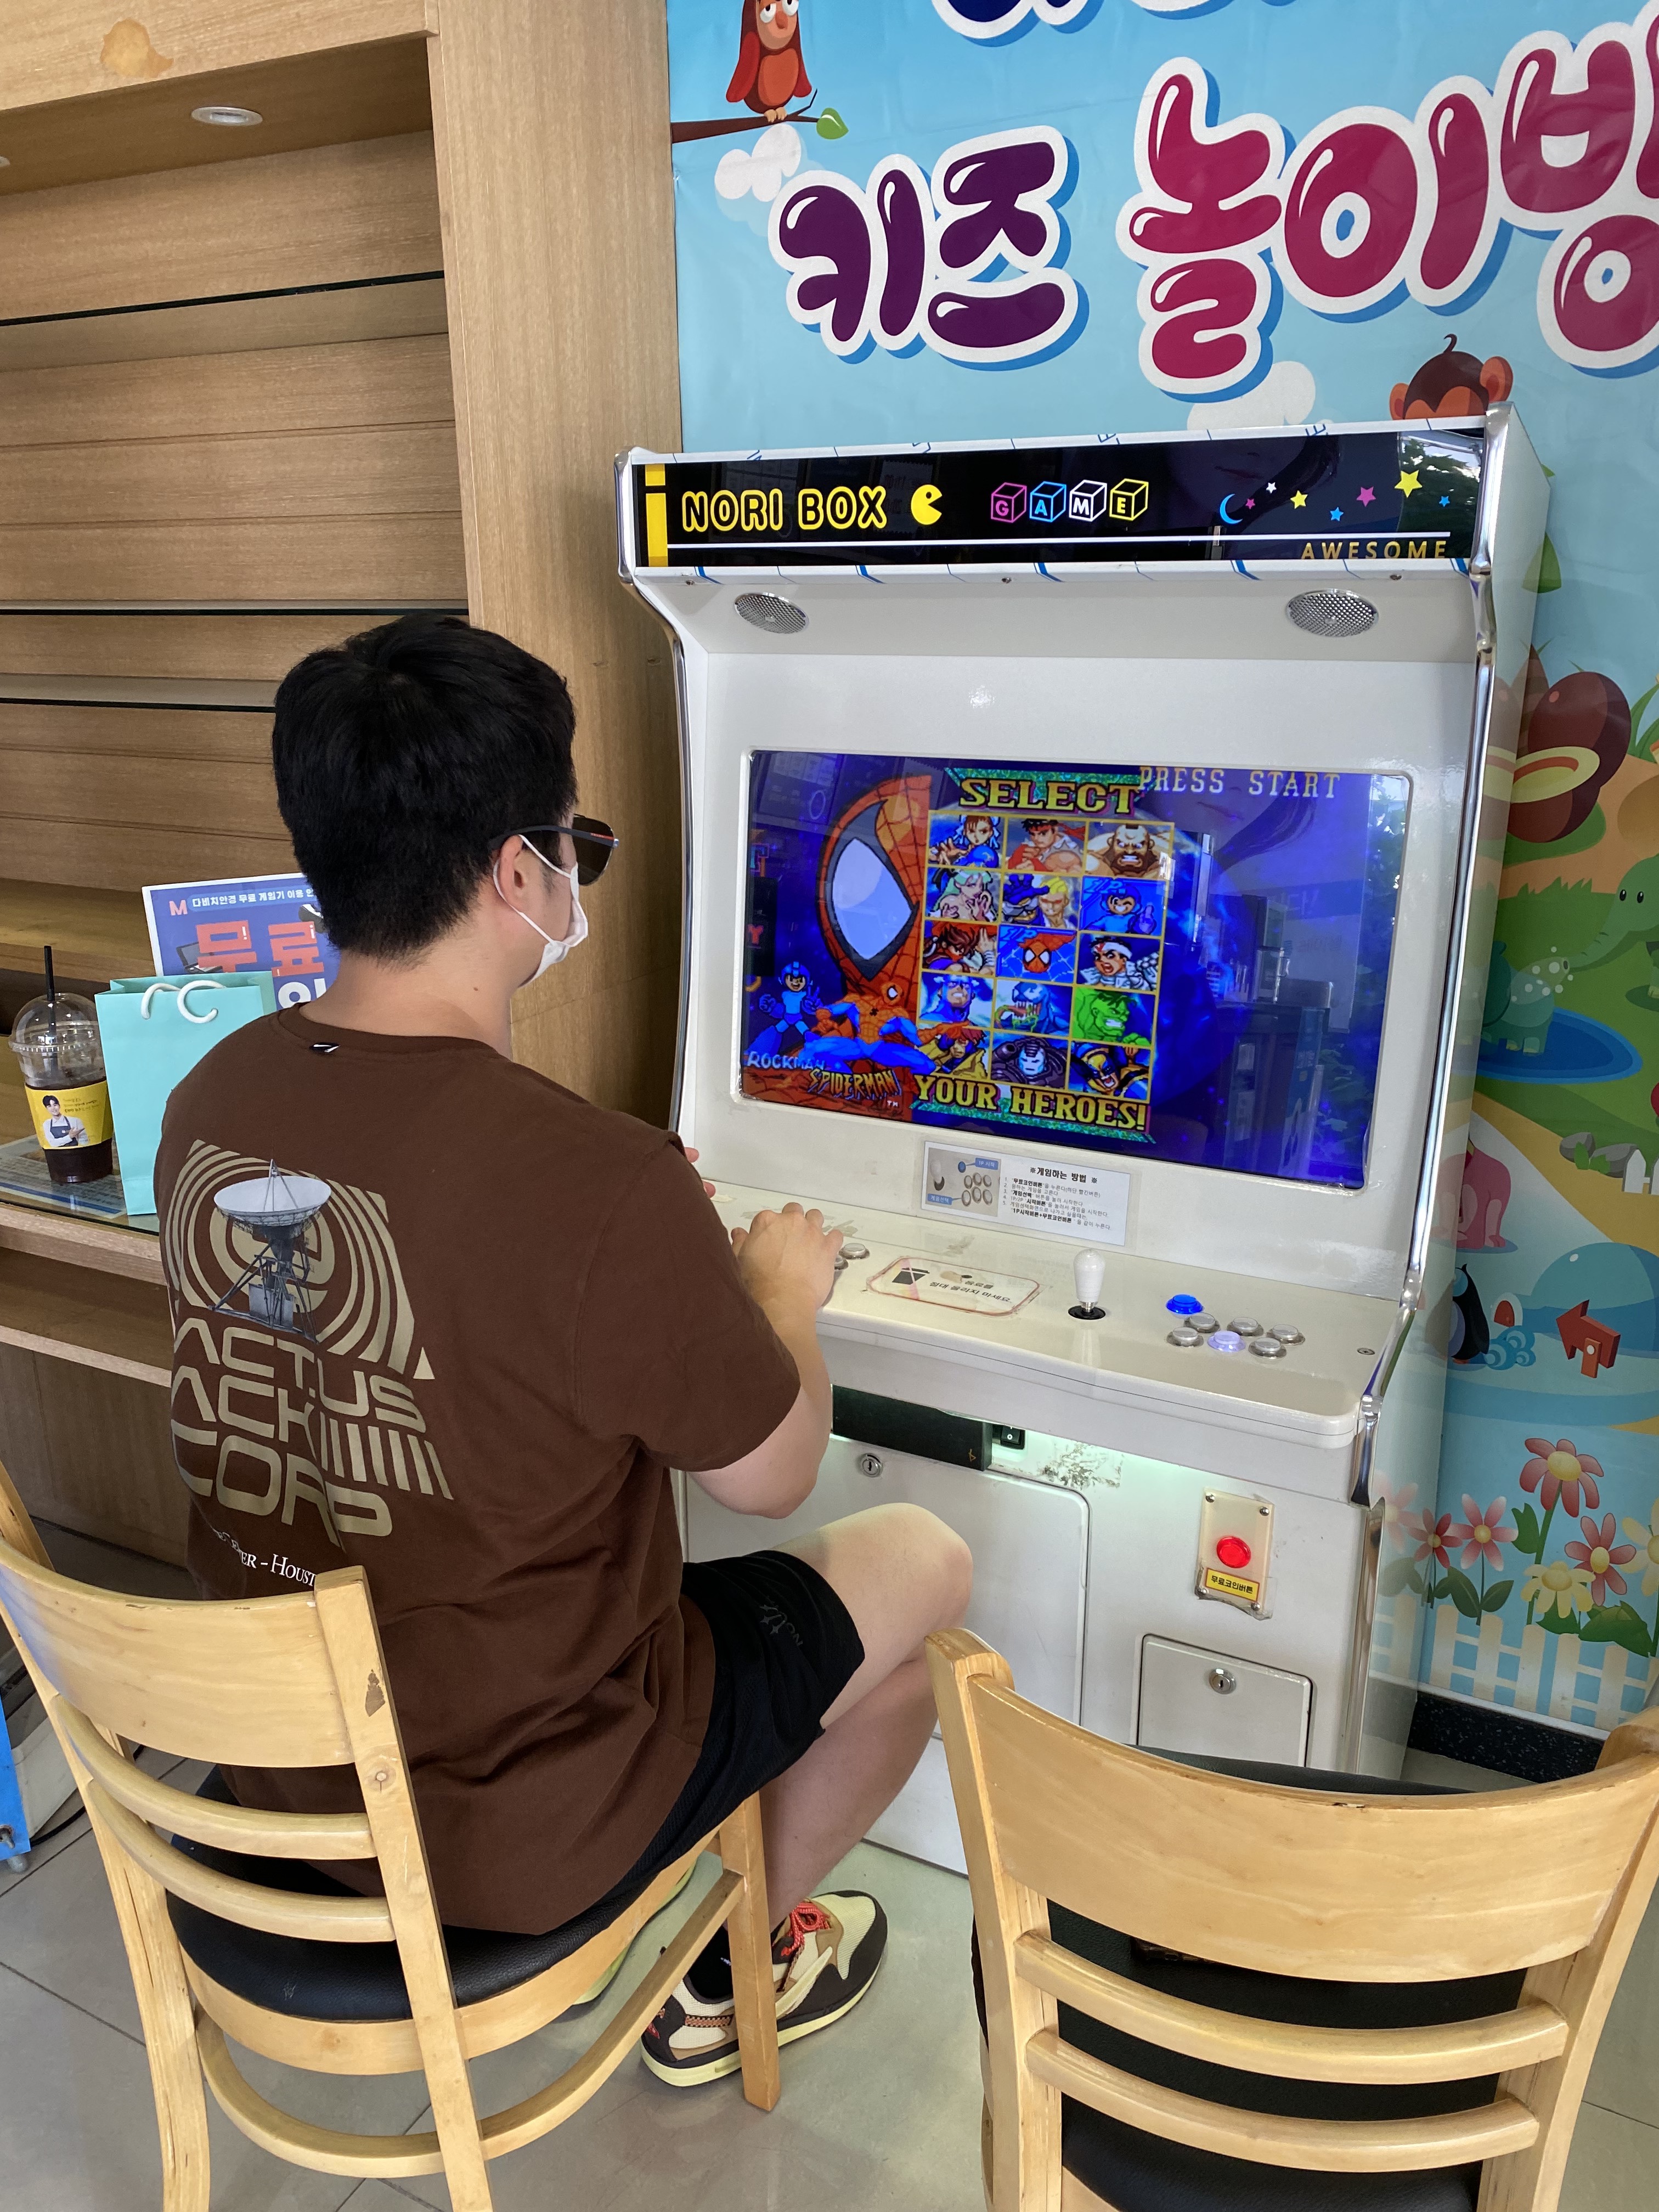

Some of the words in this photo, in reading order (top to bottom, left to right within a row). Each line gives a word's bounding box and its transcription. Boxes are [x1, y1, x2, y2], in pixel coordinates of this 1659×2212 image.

[778, 139, 1068, 349] 키즈
[682, 488, 784, 533] NORI
[797, 485, 888, 531] BOX
[1301, 539, 1447, 560] AWESOME
[959, 778, 1139, 815] SELECT
[1139, 766, 1225, 794] PRESS
[1248, 770, 1342, 800] START
[192, 895, 236, 907] 다비치안경
[239, 894, 257, 903] 무료
[258, 891, 285, 901] 게임기
[287, 889, 304, 899] 이용
[196, 920, 325, 978] 무료
[913, 1075, 997, 1110] YOUR
[1011, 1086, 1147, 1131] HEROES!
[1071, 1172, 1087, 1183] 방법
[1211, 1575, 1254, 1594] 무료코인버튼
